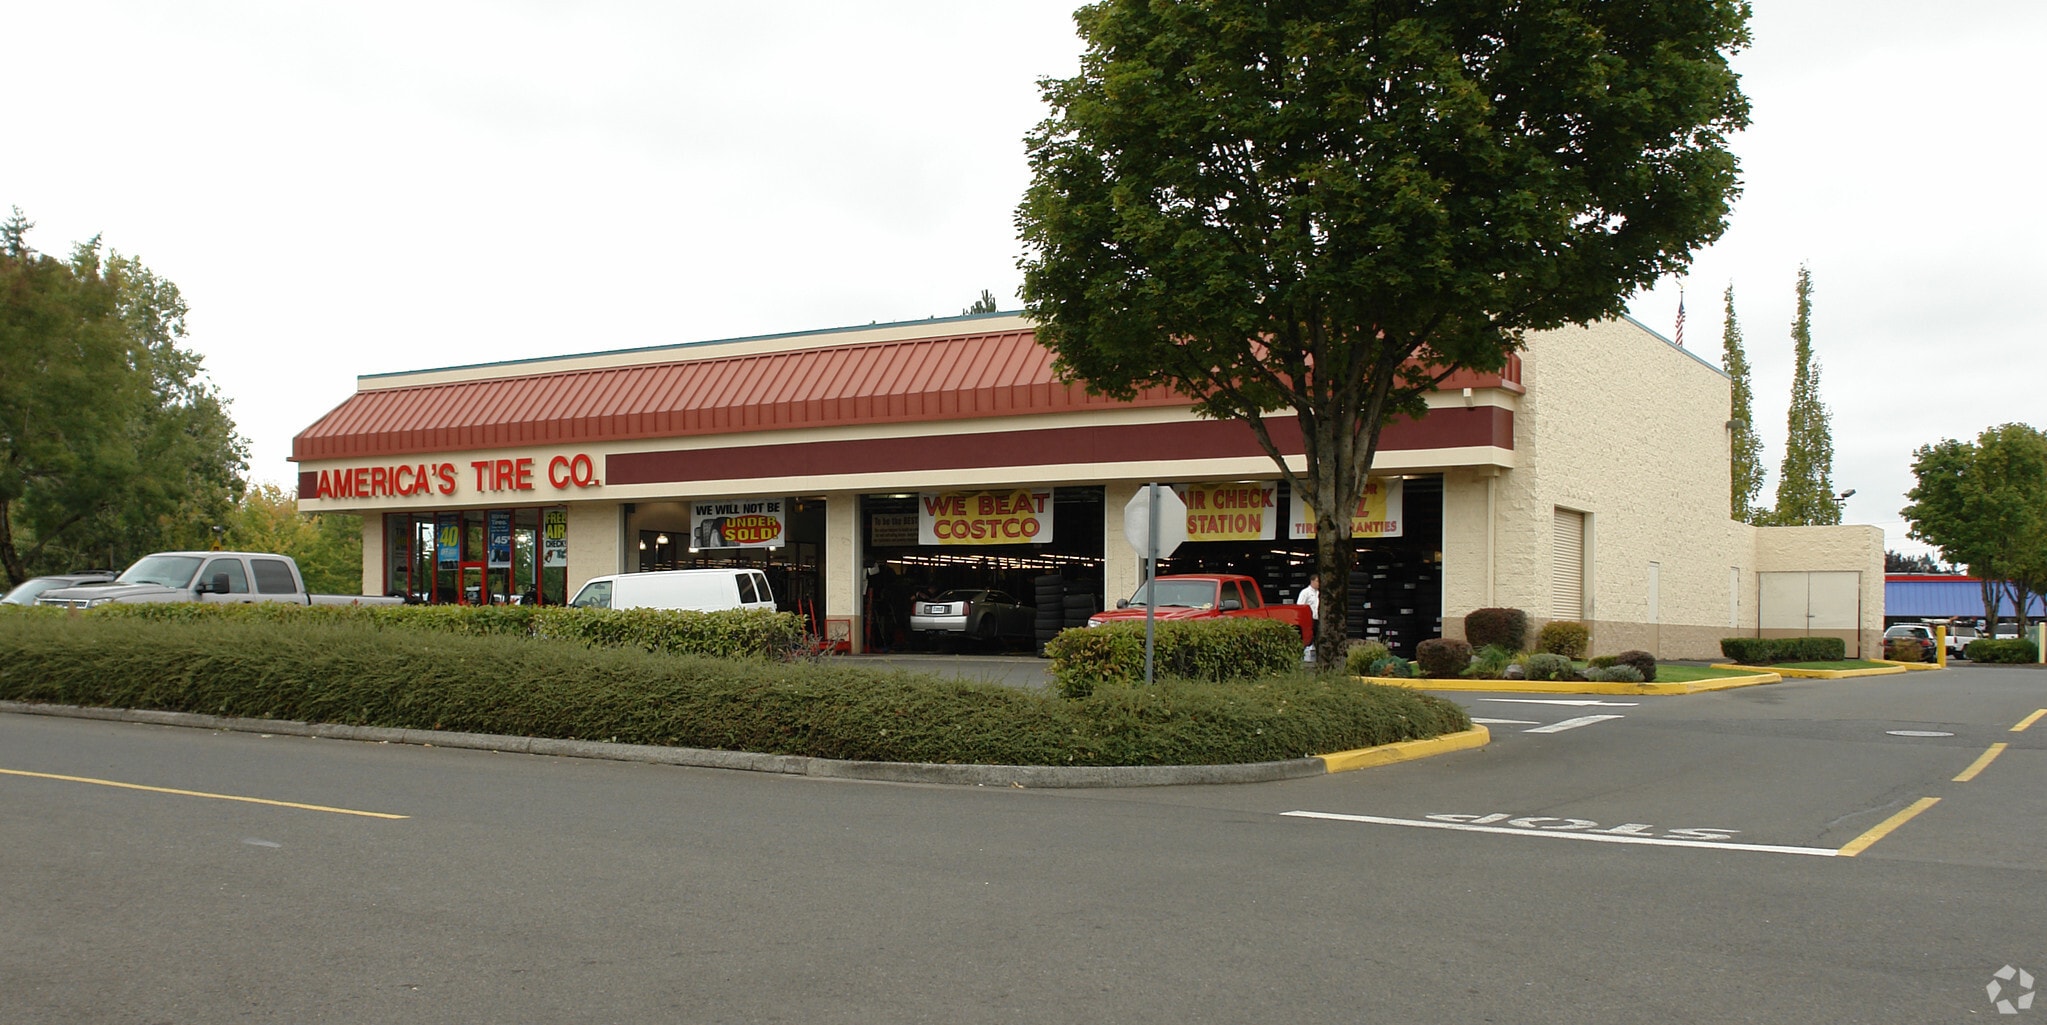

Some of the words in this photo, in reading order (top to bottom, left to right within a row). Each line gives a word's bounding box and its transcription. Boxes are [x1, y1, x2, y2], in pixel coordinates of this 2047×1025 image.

[316, 463, 456, 499] AMERICA'S
[471, 458, 533, 492] TIRE
[548, 453, 600, 490] CO.
[1362, 483, 1378, 495] OR
[924, 496, 967, 516] WE
[978, 493, 1050, 515] BEAT
[1178, 491, 1206, 510] AIR
[1212, 488, 1274, 509] CHECK
[696, 505, 713, 515] WE
[715, 504, 740, 514] WILL
[743, 503, 764, 514] NOT
[767, 502, 780, 512] BE
[545, 512, 566, 524] FREE
[726, 516, 777, 528] UNDER
[1187, 514, 1261, 534] STATION
[546, 524, 566, 540] AIR
[724, 528, 778, 540] SOLD!
[933, 518, 1041, 539] COSTCO
[1350, 521, 1397, 533] RANTIES
[1425, 812, 1741, 840] STOP
